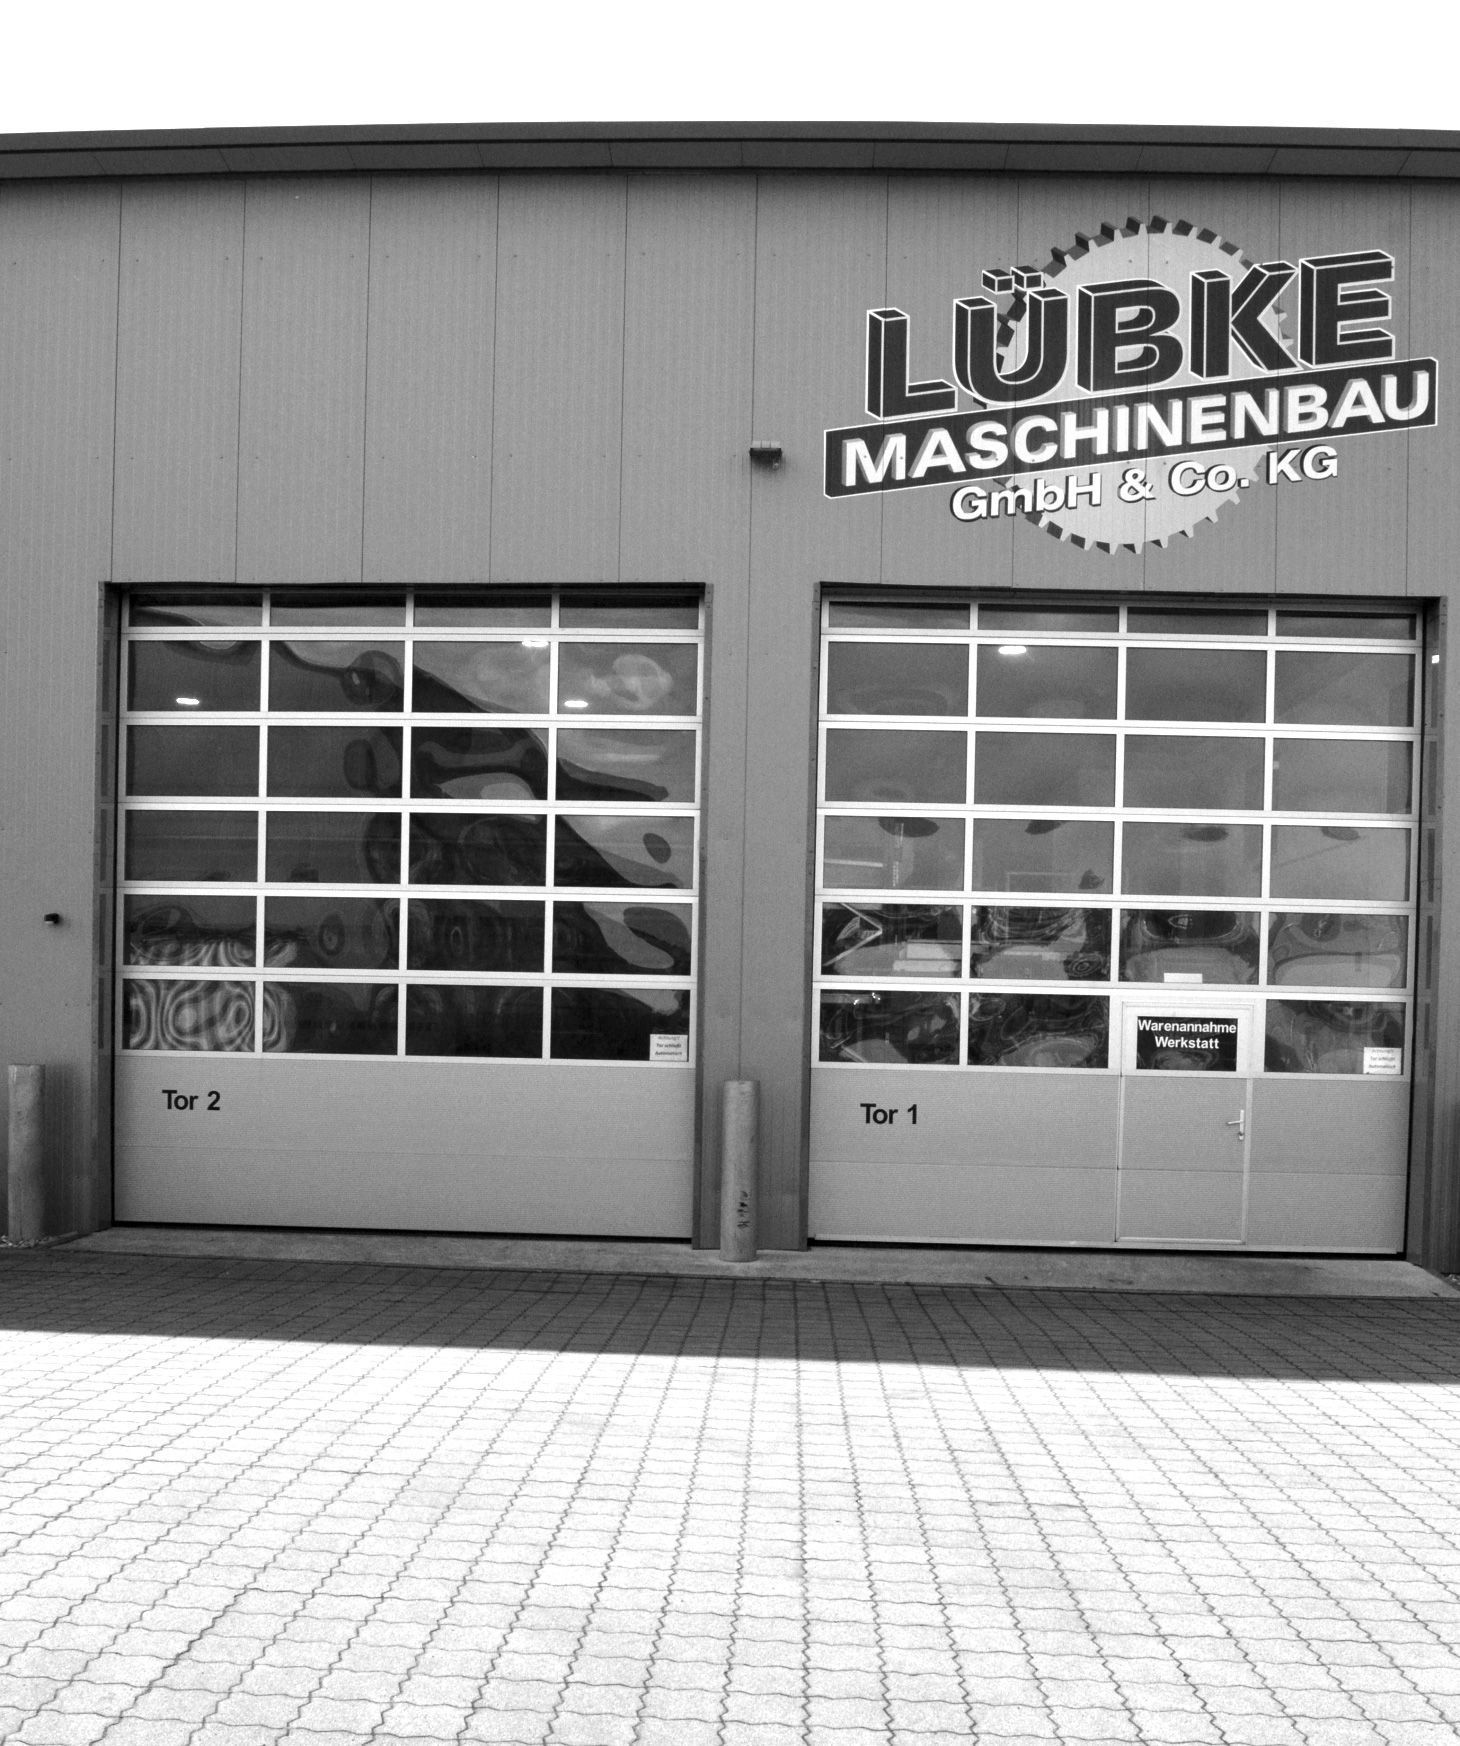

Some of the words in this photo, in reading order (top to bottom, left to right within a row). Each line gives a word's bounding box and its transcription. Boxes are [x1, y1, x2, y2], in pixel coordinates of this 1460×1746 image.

[865, 249, 1395, 420] LÜBKE
[842, 369, 1430, 487] MASCHINENBAU
[951, 473, 1101, 521] GmbH
[1119, 467, 1155, 502] &
[1169, 461, 1250, 496] Co.
[1268, 445, 1339, 484] KG
[1138, 1019, 1237, 1034] Warenannahme
[1154, 1036, 1220, 1049] Werkstatt
[162, 1090, 199, 1110] Tor
[207, 1090, 221, 1111] 2
[860, 1103, 899, 1125] Tor
[907, 1104, 917, 1125] 1
